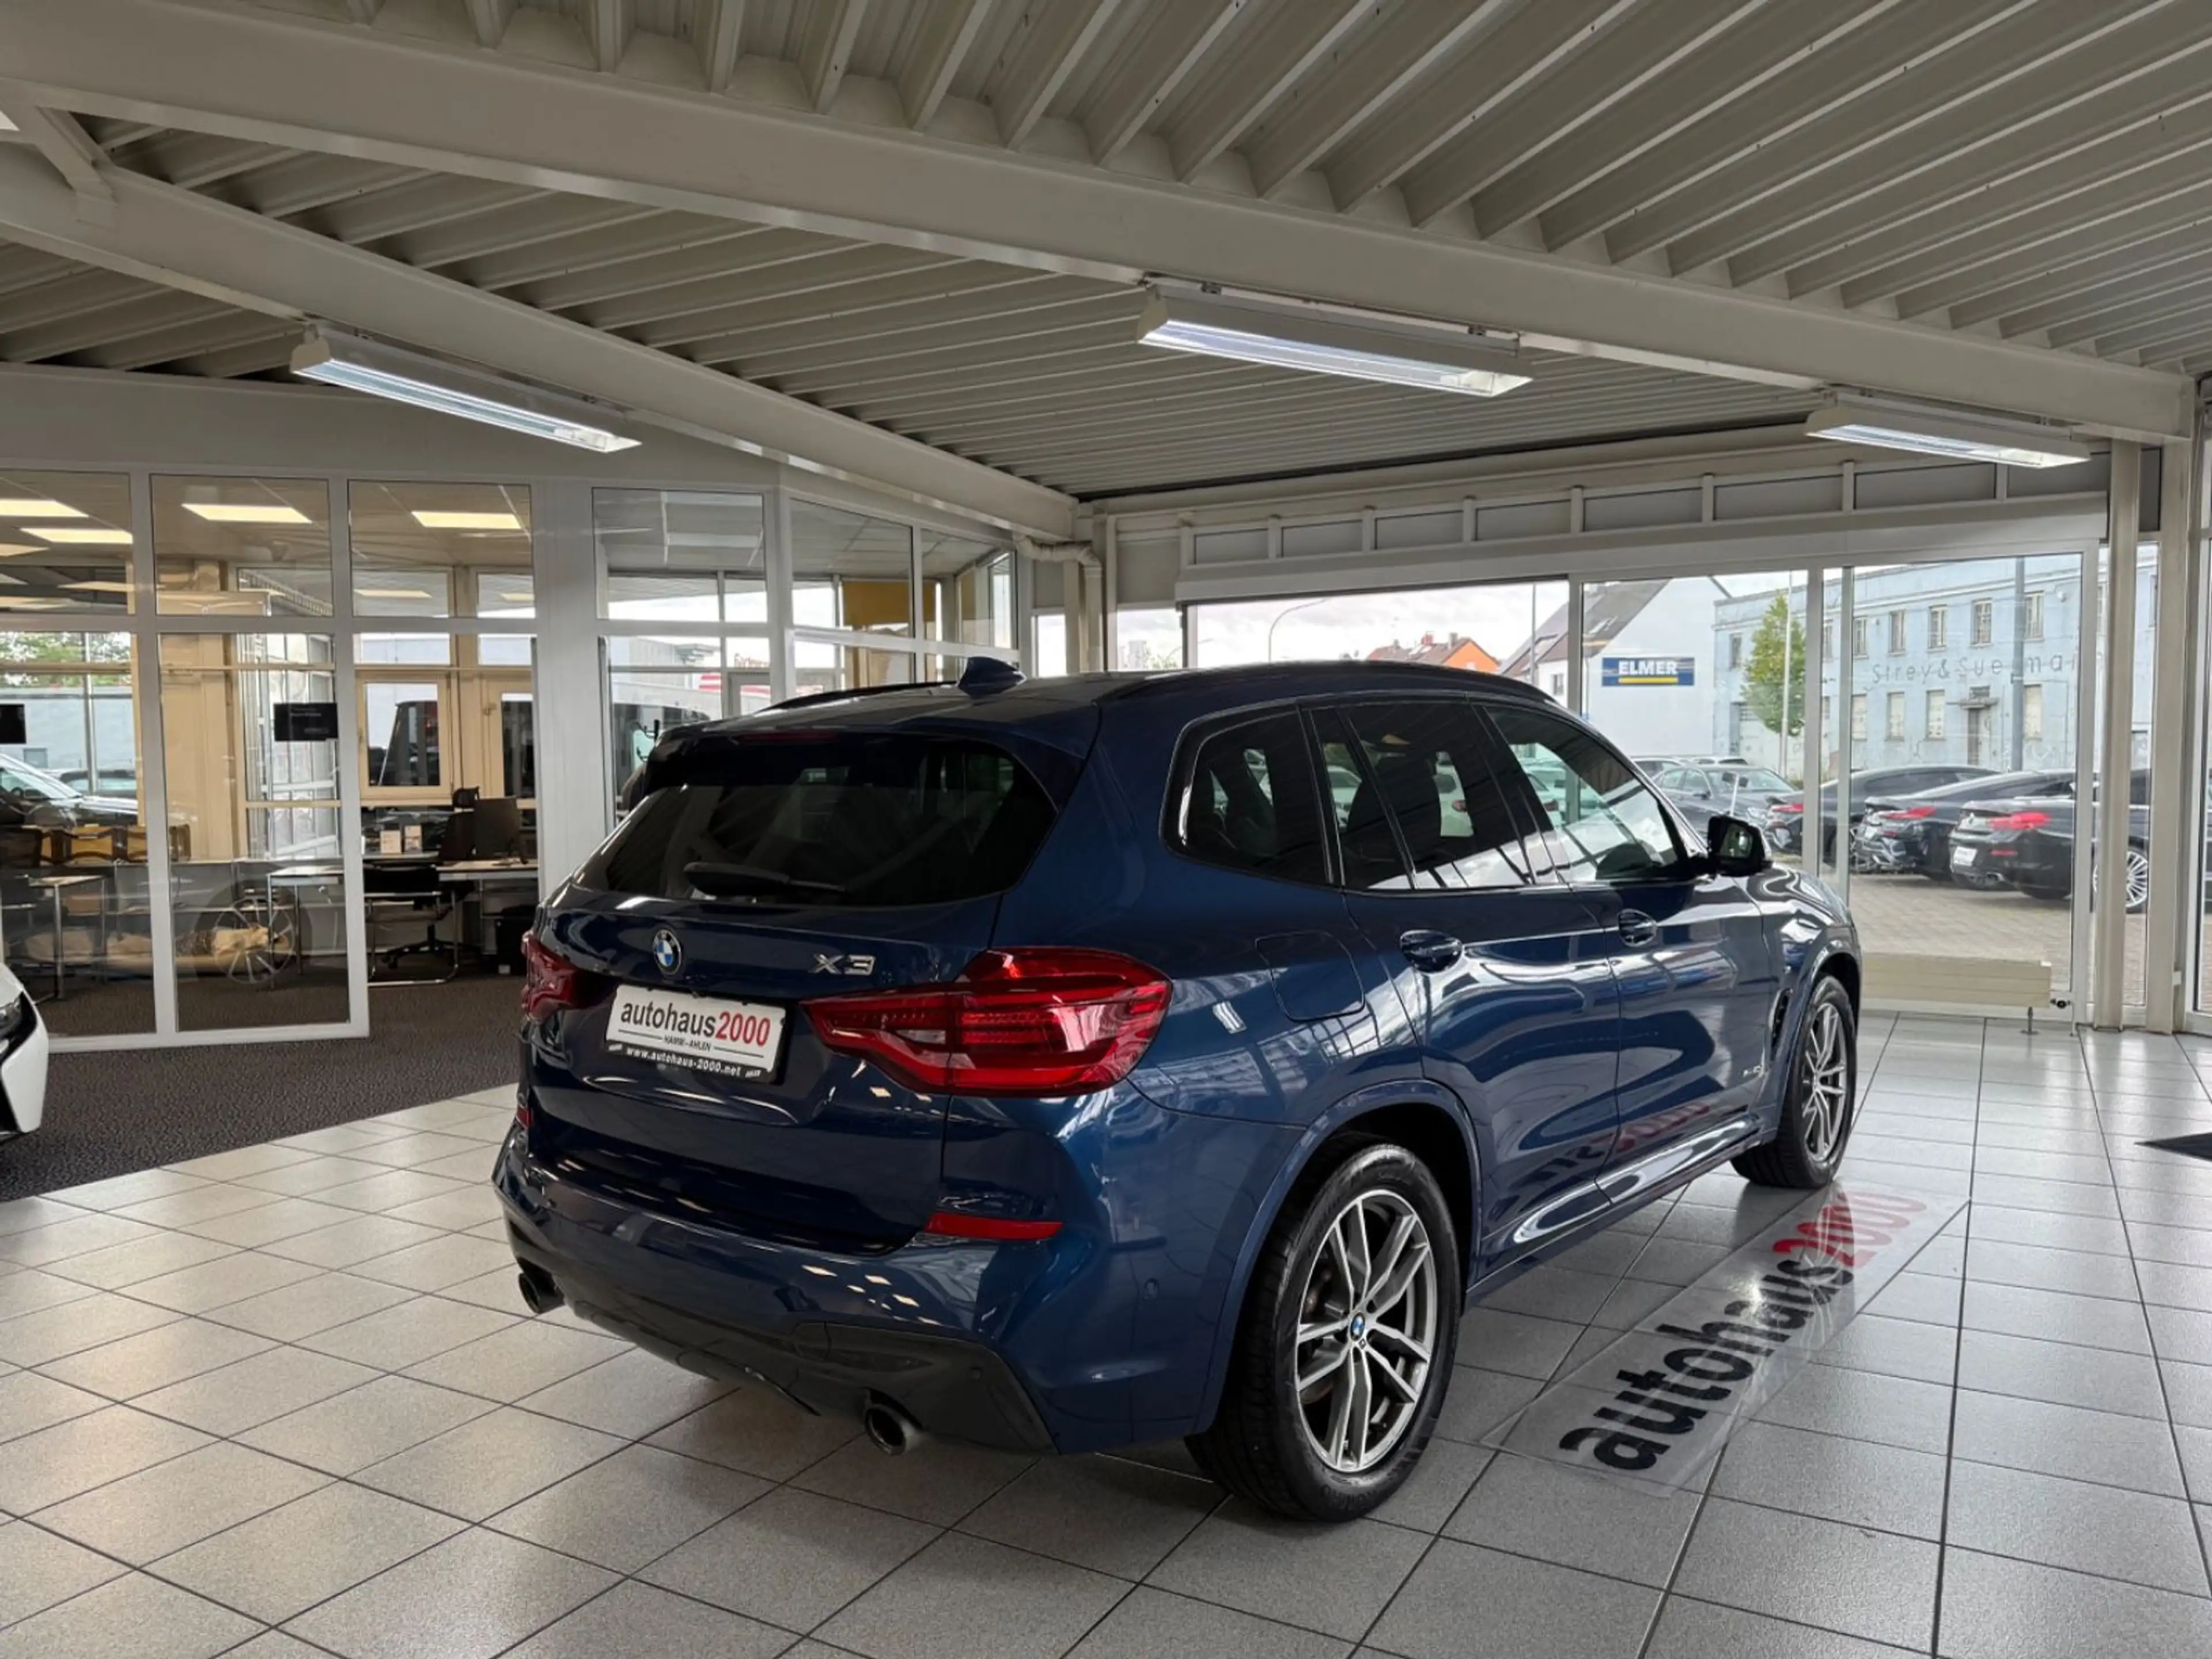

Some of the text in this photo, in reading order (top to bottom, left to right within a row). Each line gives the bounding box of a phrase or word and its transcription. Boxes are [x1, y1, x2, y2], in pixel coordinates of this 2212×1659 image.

[1619, 660, 1677, 675] ELMER
[807, 953, 876, 975] X3
[620, 1001, 771, 1047] autohaus2000
[626, 1047, 741, 1077] www.autohaus-2000.net
[1559, 1191, 1927, 1471] autohaus2000
